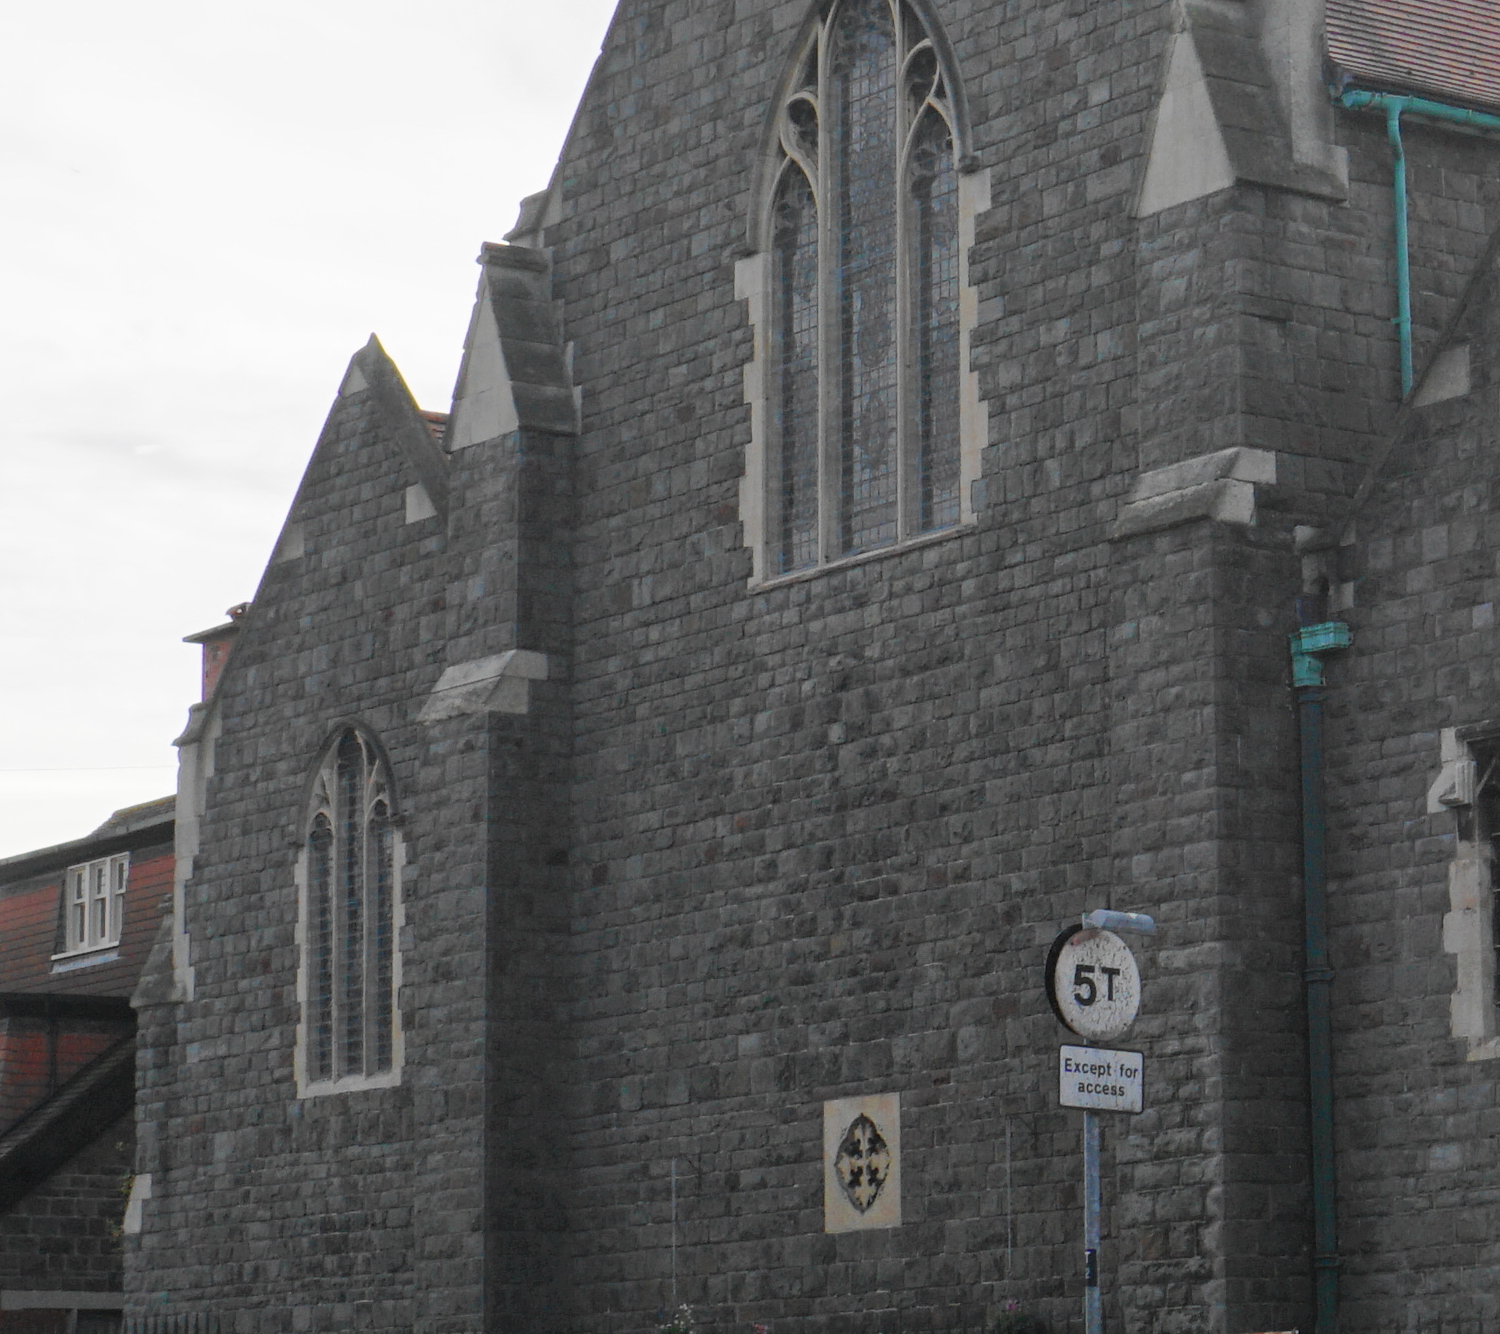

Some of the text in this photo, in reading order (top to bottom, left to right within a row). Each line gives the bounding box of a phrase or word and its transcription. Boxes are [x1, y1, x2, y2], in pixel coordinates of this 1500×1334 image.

[1064, 1058, 1139, 1079] Except for
[1078, 1081, 1125, 1097] access
